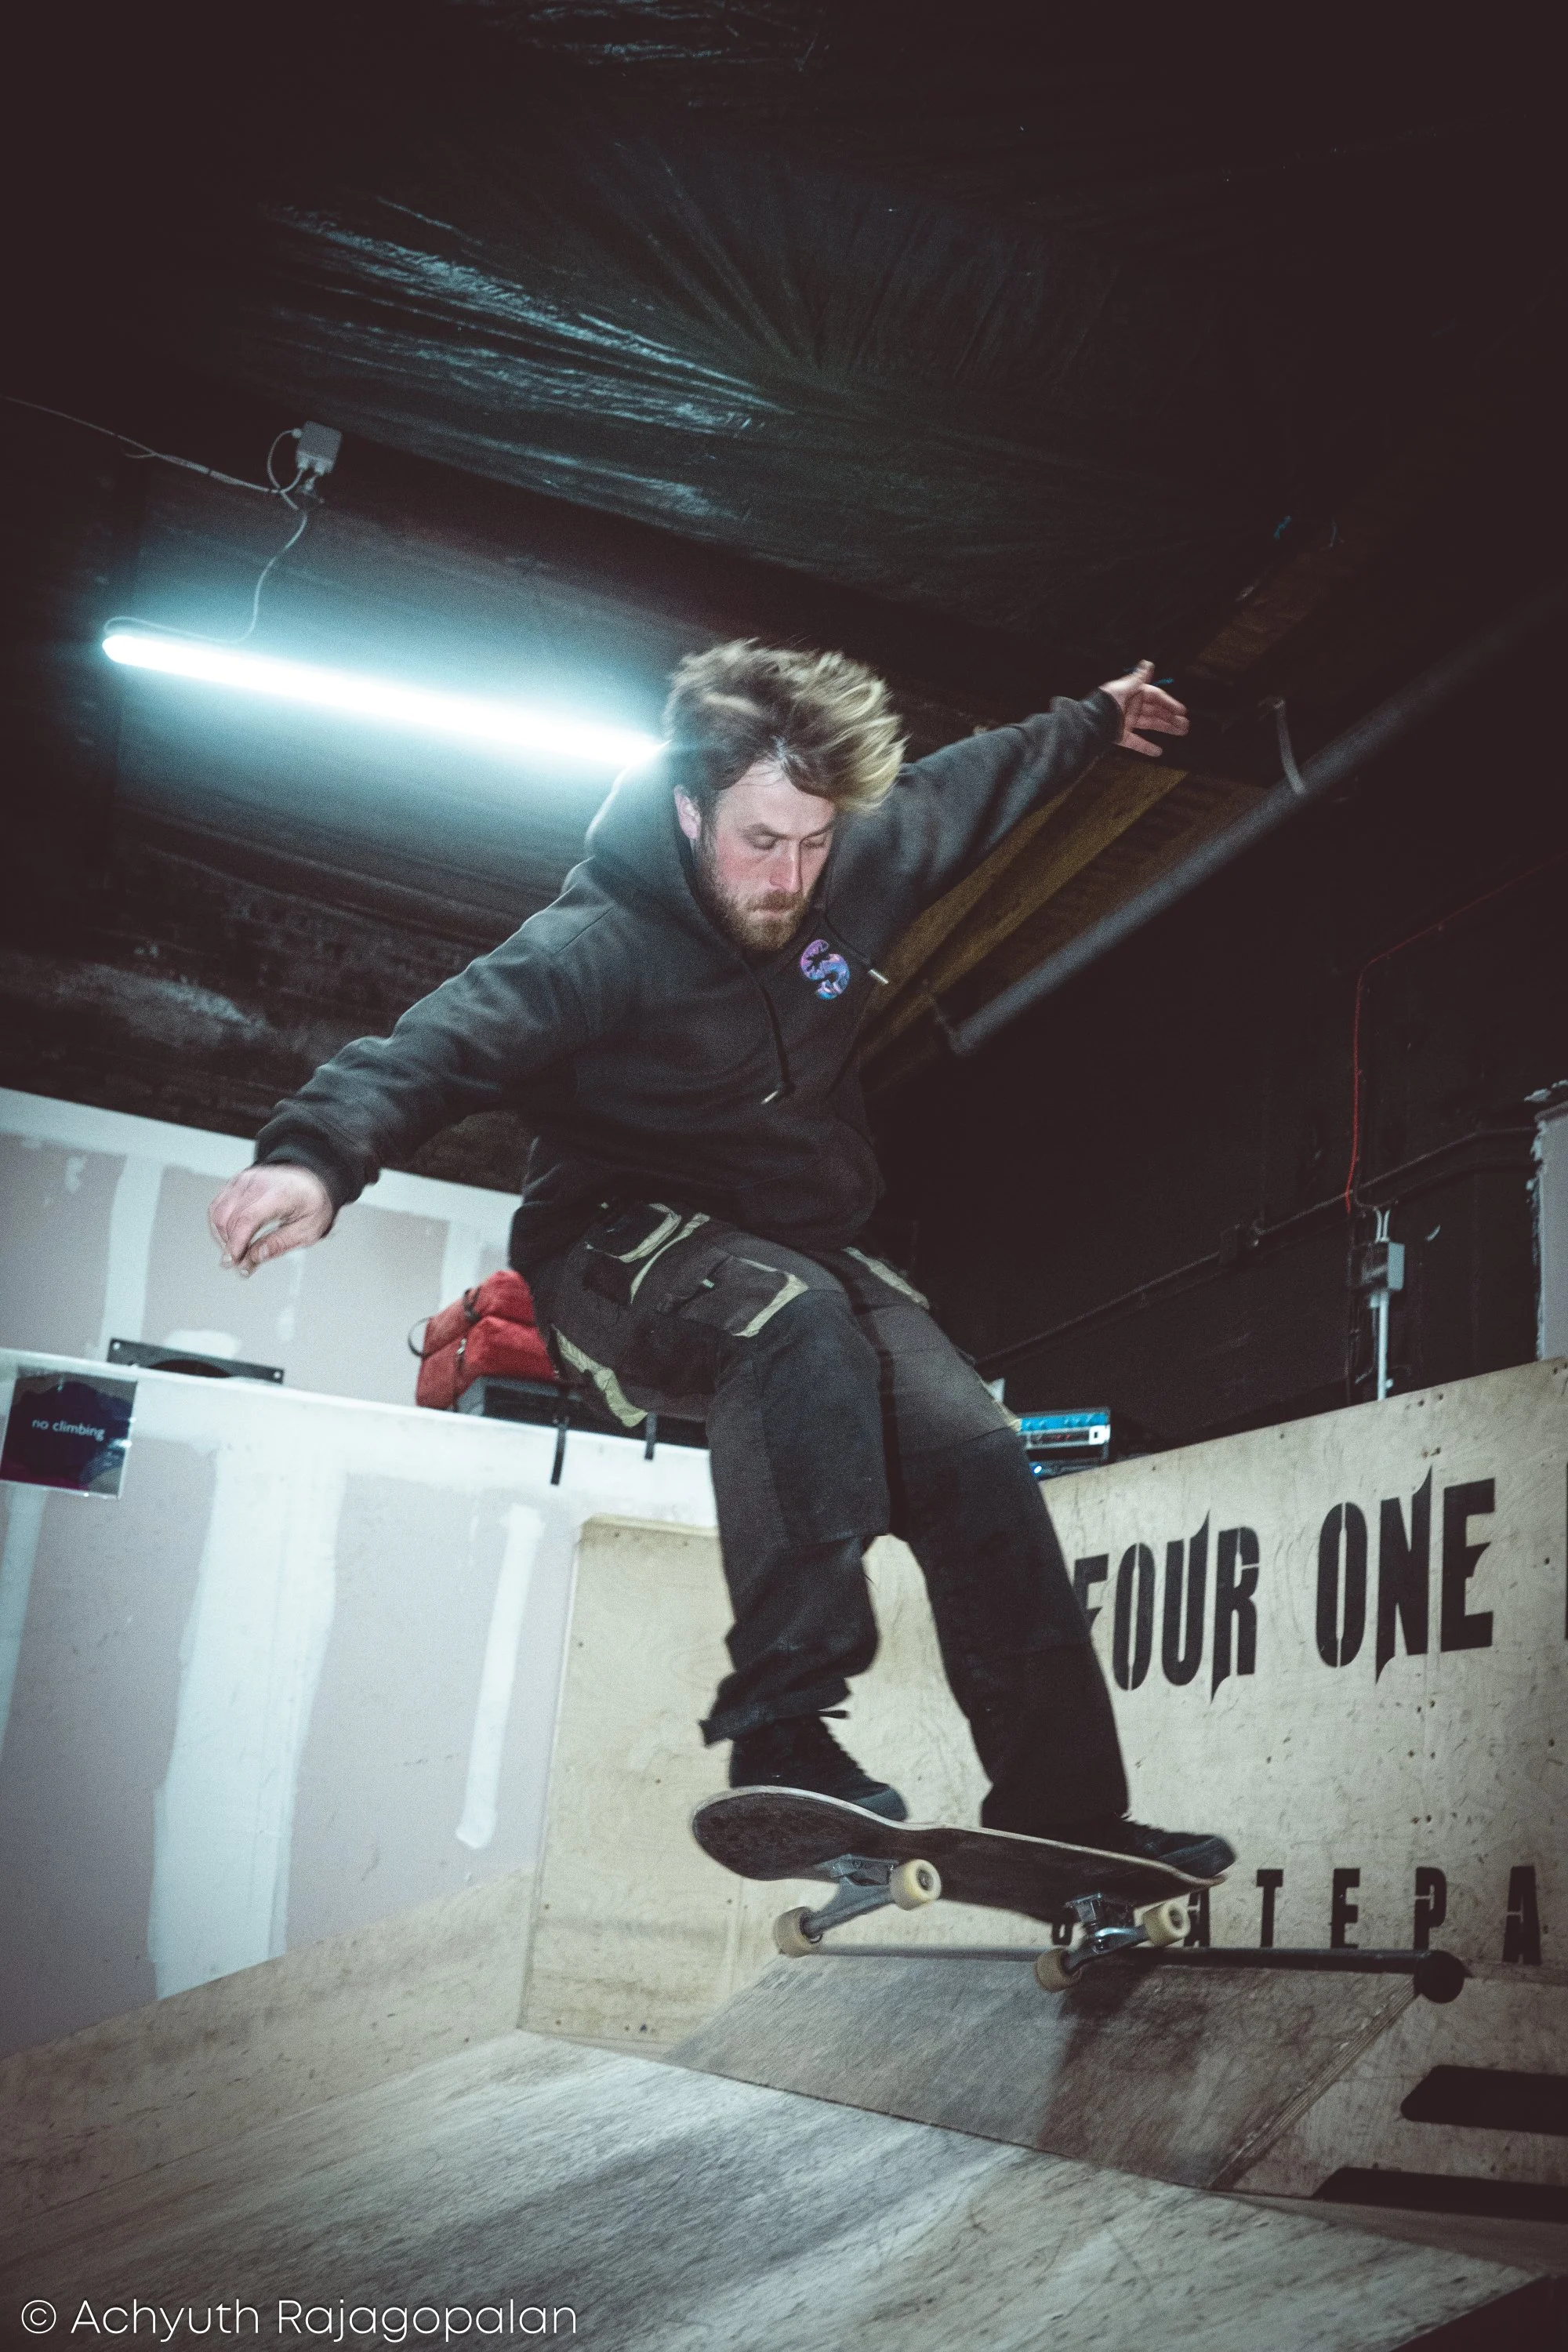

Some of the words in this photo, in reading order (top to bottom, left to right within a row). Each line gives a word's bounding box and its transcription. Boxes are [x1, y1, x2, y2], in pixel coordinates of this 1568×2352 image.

[31, 1419, 49, 1430] no
[52, 1420, 106, 1442] climbing
[1315, 1464, 1496, 1686] ONE
